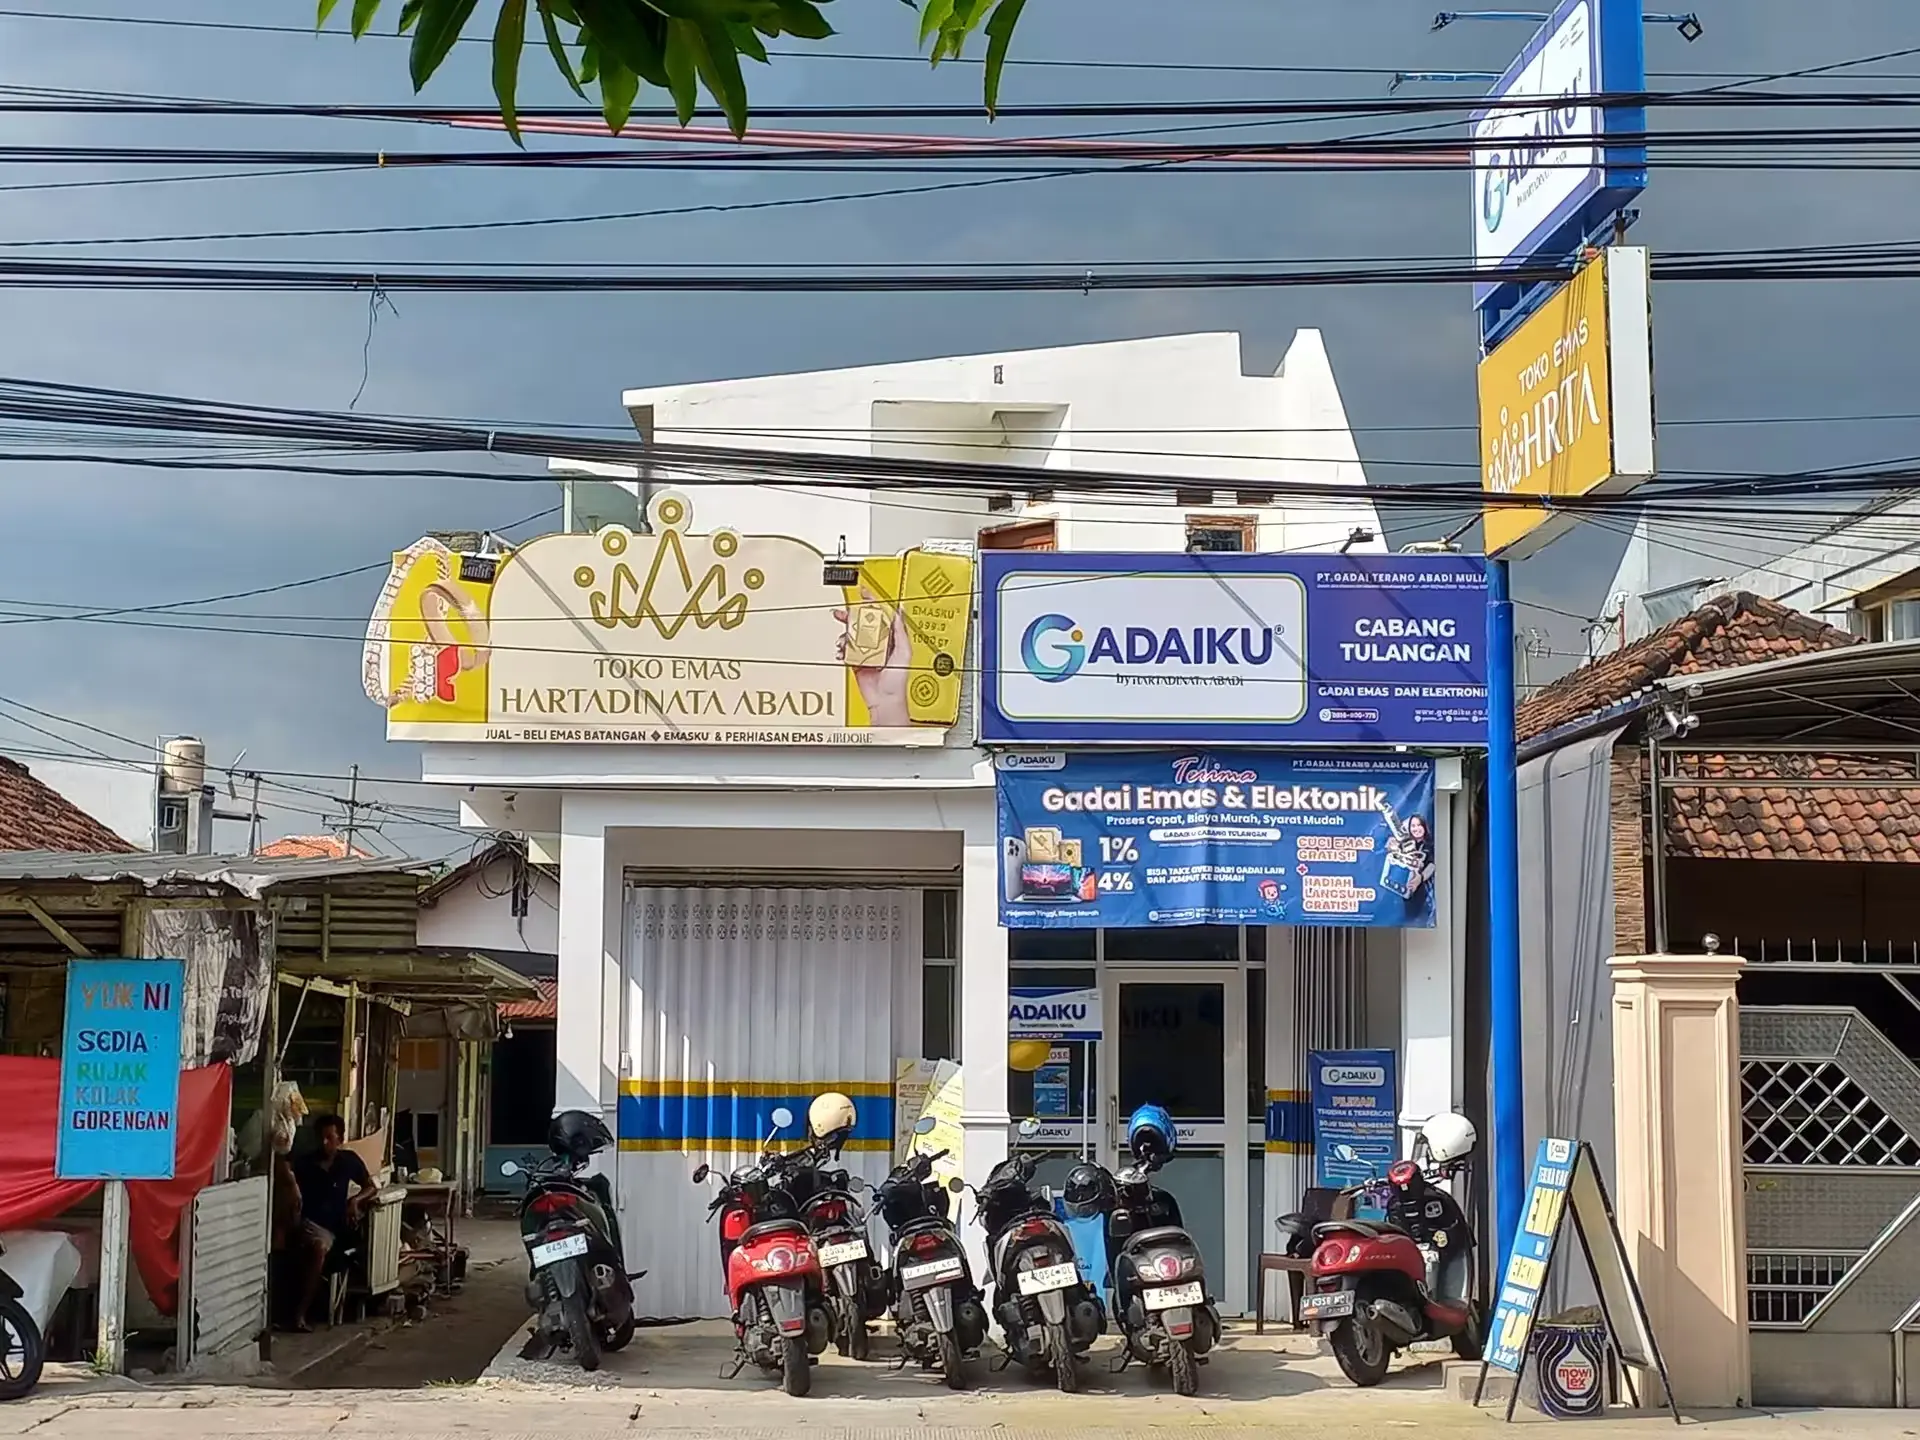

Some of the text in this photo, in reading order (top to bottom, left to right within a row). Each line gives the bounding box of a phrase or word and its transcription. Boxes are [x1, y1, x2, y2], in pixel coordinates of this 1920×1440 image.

[1518, 316, 1589, 396] TOKO EMAS
[1521, 361, 1600, 478] HRTA
[1372, 573, 1416, 582] TERANG
[1418, 573, 1453, 582] ABADI
[912, 606, 954, 619] EMASKU
[1355, 618, 1456, 637] CABANG
[1021, 613, 1272, 683] GADAIKU
[1340, 643, 1470, 662] TULANGAN
[594, 658, 741, 679] TOKO EMAS
[1318, 687, 1355, 697] GADAI
[1357, 687, 1389, 697] EMAS
[1395, 687, 1420, 697] DAN
[500, 688, 835, 717] HARTADINATA ABADI
[485, 729, 512, 740] JUAL
[523, 730, 547, 740] BELI
[550, 730, 581, 741] EMAS
[584, 730, 646, 741] BATANGAN
[664, 731, 709, 741] EMASKU
[715, 731, 722, 742] &
[726, 731, 789, 742] PERHIASAN
[792, 732, 823, 743] EMAS
[1005, 755, 1056, 767] GADAIKU
[1172, 755, 1257, 782] Terima
[1042, 784, 1388, 812] Gadai Emas & Elektonik
[1106, 813, 1344, 827] Proses Cepat, Biaya Murah, Syarat Mudah
[1099, 837, 1139, 863] 1%
[1299, 837, 1373, 848] CUCI EMAS
[1098, 872, 1134, 891] 4%
[143, 982, 170, 1010] NI
[1008, 1004, 1086, 1020] ADAIKU
[77, 1062, 147, 1081] RUJAK
[1329, 1069, 1376, 1082] GADAIKU
[73, 1111, 169, 1131] GORENGAN
[1035, 1128, 1070, 1137] ADAIKU
